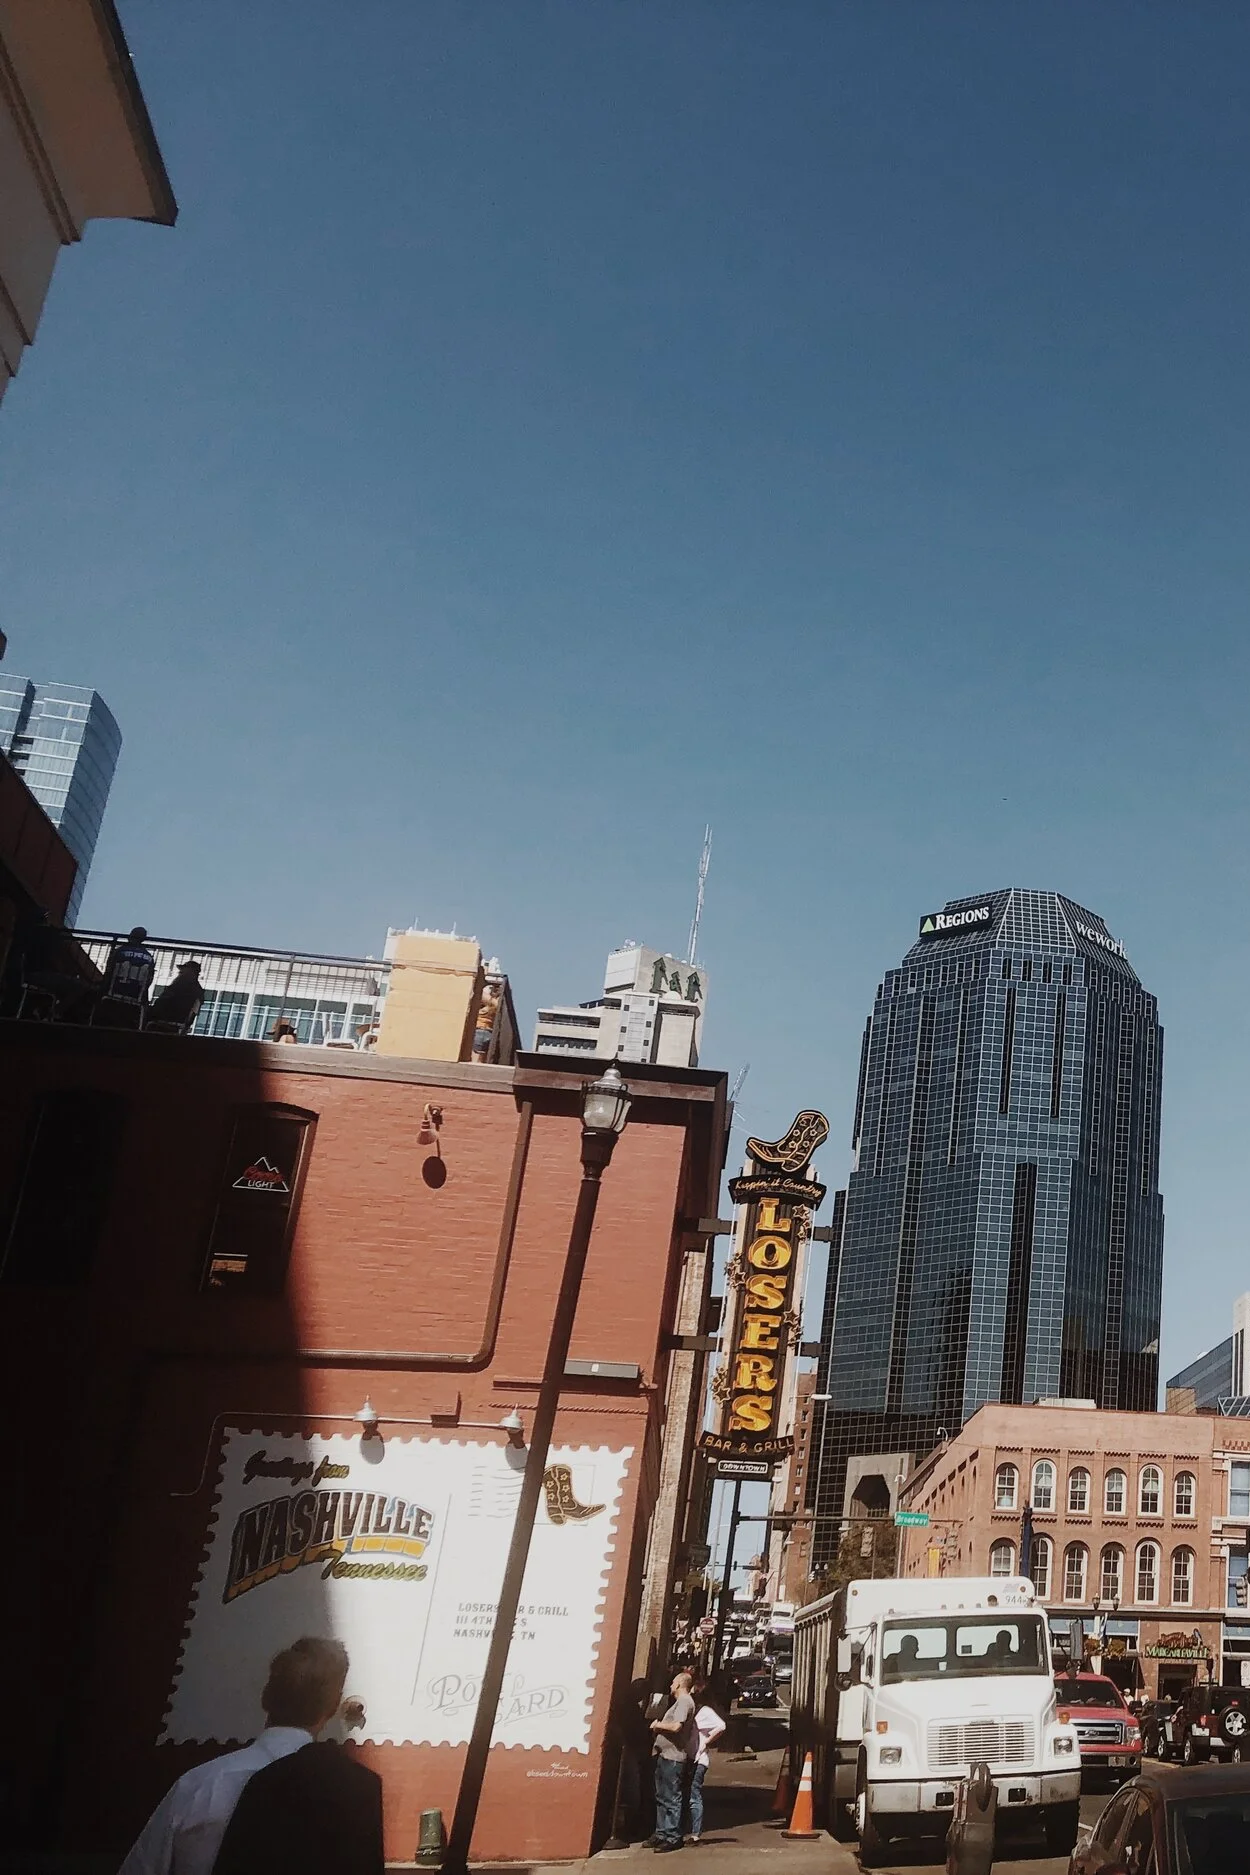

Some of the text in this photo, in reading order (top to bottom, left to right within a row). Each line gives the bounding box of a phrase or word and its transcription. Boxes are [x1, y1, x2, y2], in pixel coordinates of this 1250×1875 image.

[934, 907, 990, 931] REGIONS
[1075, 921, 1127, 960] wework
[247, 1180, 275, 1188] LIGHT
[728, 1197, 792, 1433] LOSERS
[704, 1435, 794, 1454] BAR & GRILL
[723, 1463, 765, 1472] DOWNTOWN
[230, 1489, 434, 1586] NASHVILLE
[319, 1549, 428, 1581] Tennessee
